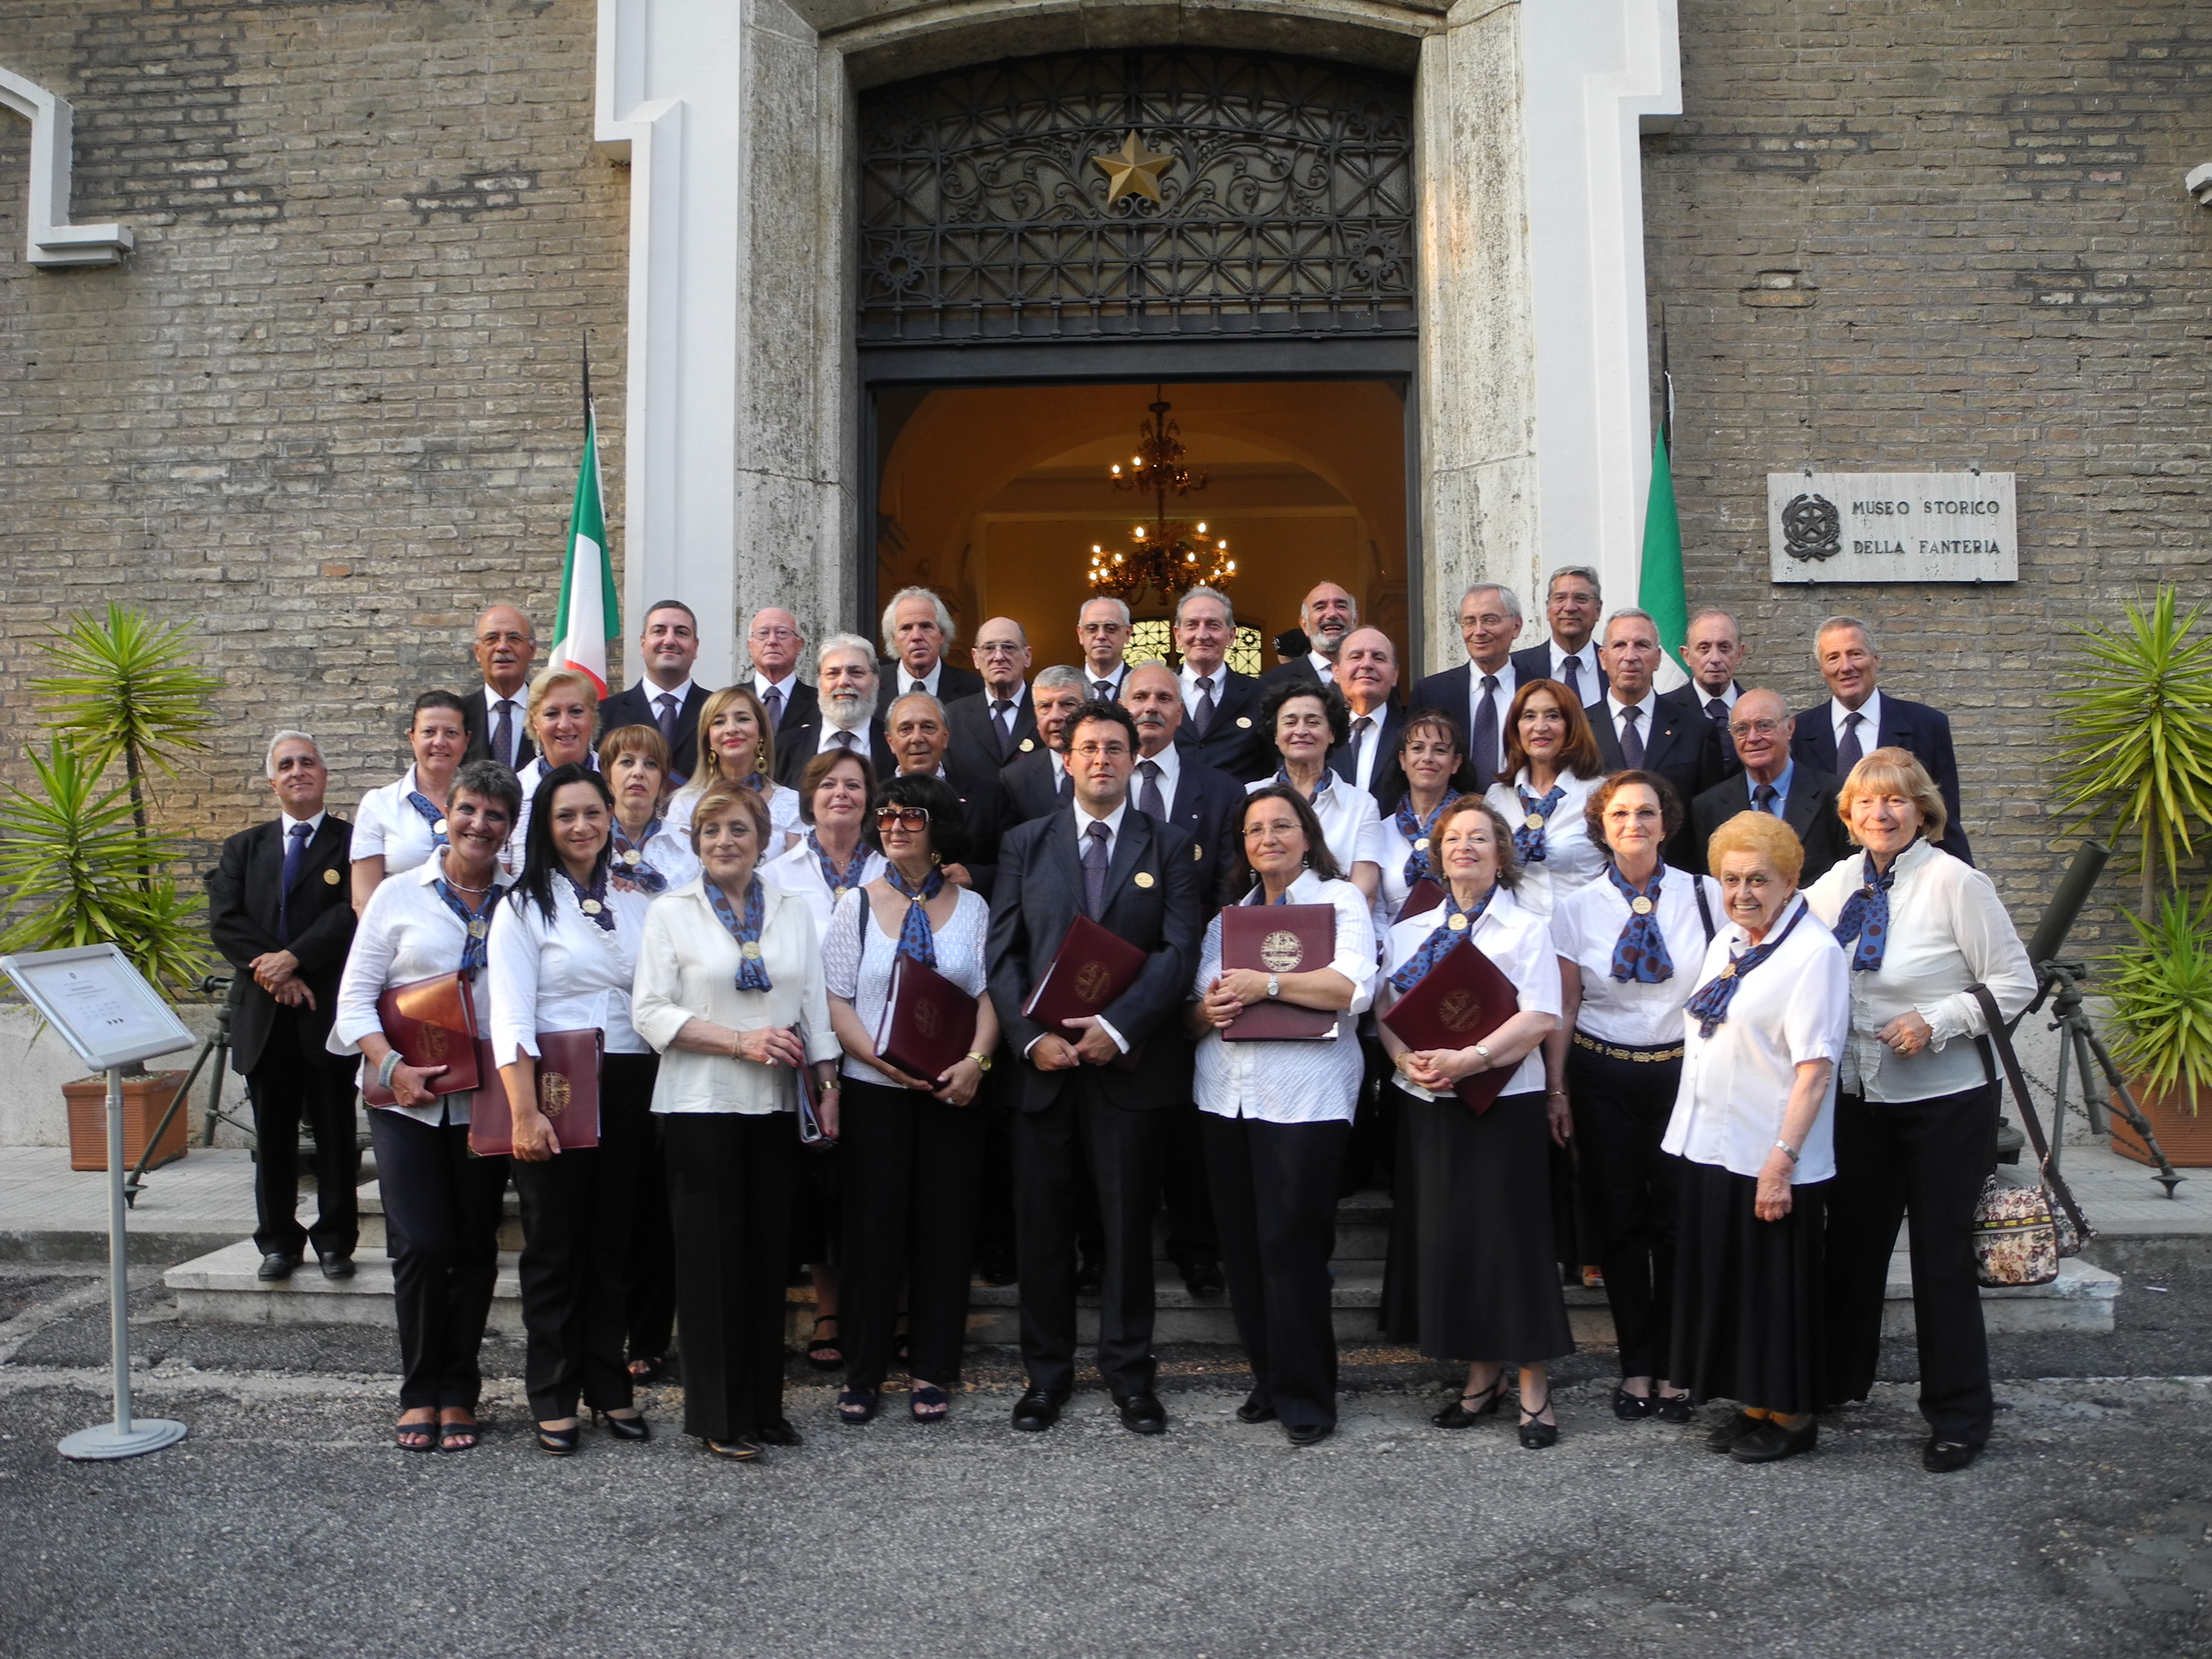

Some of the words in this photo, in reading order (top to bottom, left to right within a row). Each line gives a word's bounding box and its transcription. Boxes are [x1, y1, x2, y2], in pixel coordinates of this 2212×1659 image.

[1852, 501, 1909, 515] MUSEO
[1923, 501, 2000, 514] STORICO
[1853, 541, 1905, 554] DELLA
[1919, 540, 2000, 554] FANTERIA
